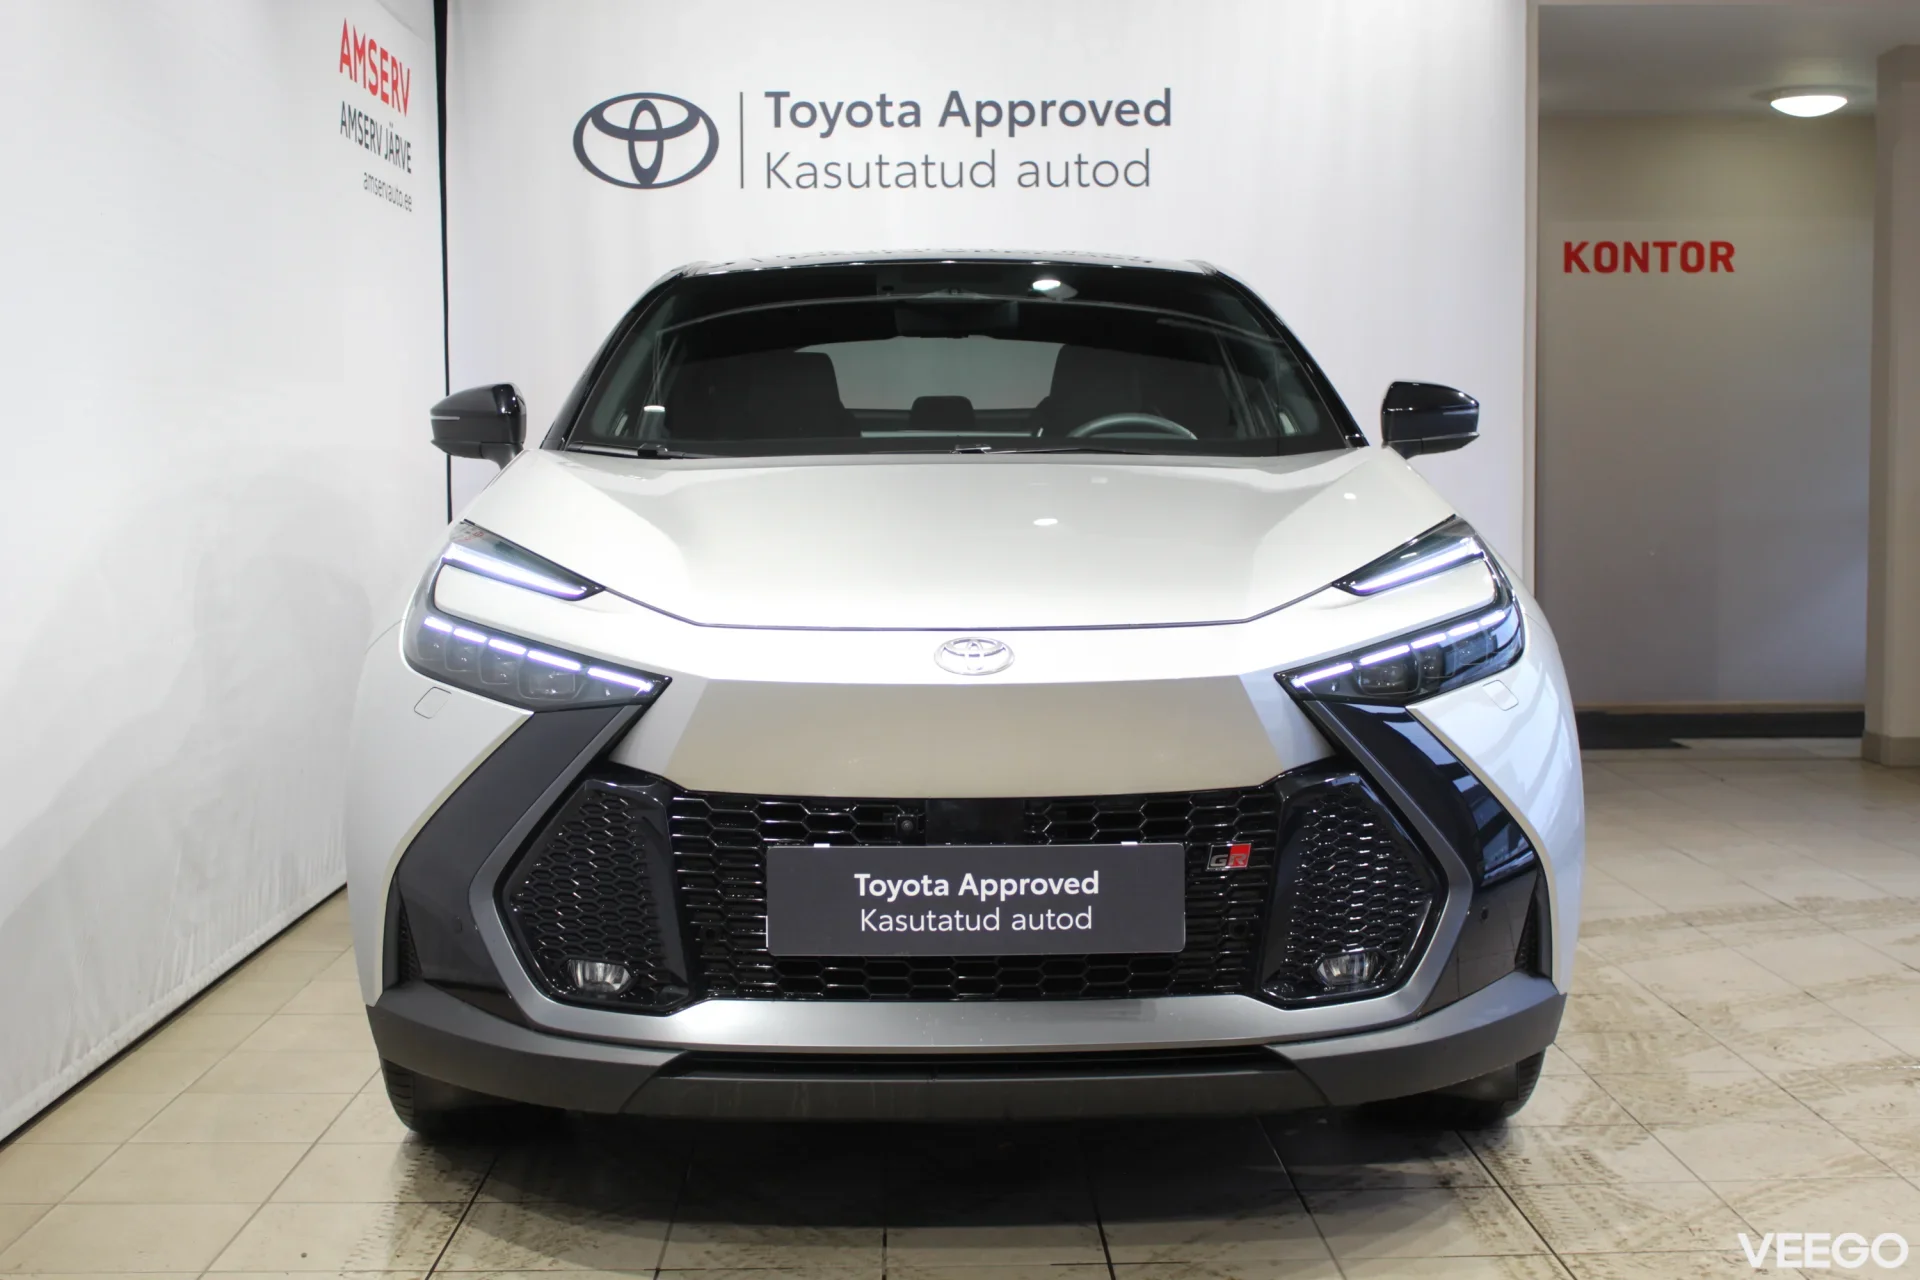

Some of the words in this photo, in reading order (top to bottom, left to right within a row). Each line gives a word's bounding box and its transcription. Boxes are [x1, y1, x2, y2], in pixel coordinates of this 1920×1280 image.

[339, 17, 411, 118] AMSERV
[764, 90, 922, 139] Toyota
[937, 87, 1172, 138] Approved
[339, 100, 383, 156] AMSERV
[384, 121, 412, 175] JÄRVE
[766, 149, 996, 190] Kasutatud
[1017, 148, 1150, 189] autod
[363, 171, 413, 213] amservauto.ee
[1563, 240, 1736, 274] KONTOR
[1210, 853, 1247, 867] GR
[853, 873, 950, 903] Toyota
[957, 870, 1099, 902] Approved
[861, 907, 1000, 932] Kasutatud
[1011, 905, 1092, 931] autod
